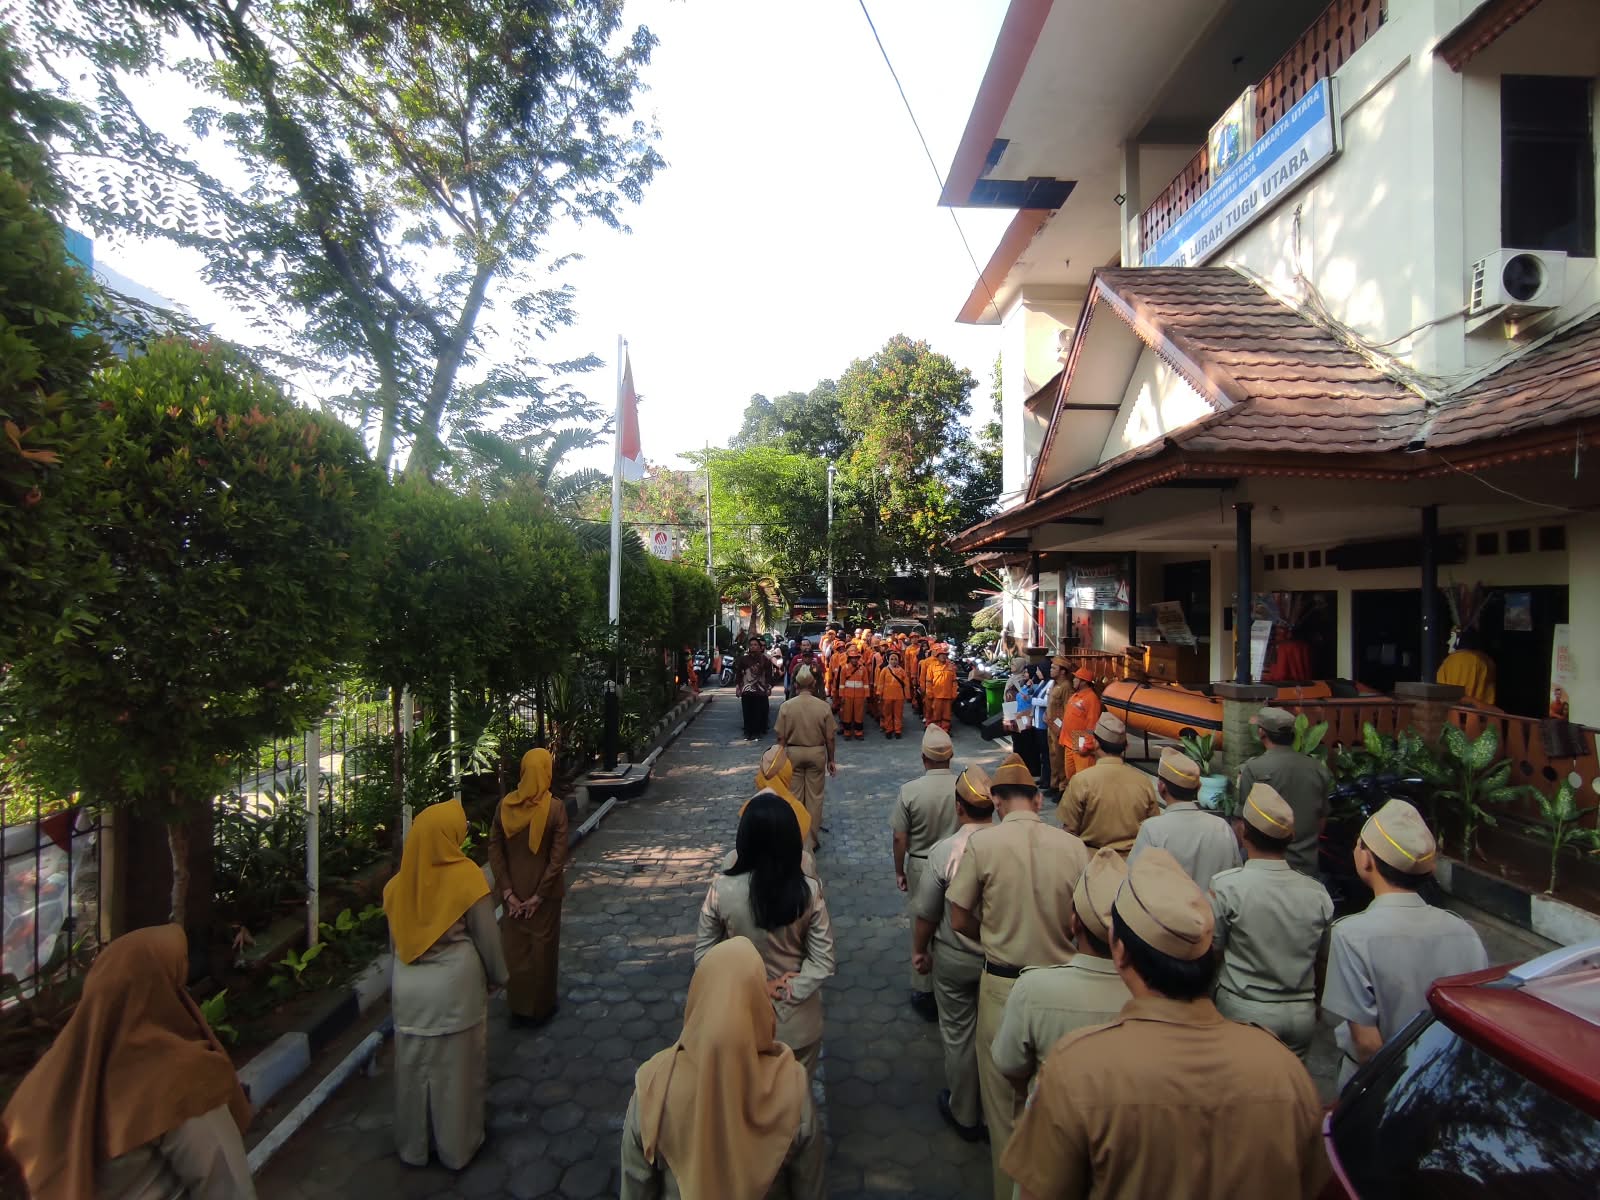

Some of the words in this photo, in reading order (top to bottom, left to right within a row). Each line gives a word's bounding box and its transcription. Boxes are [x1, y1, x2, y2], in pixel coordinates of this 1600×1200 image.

[1209, 152, 1255, 197] ADMINISTRASI
[1255, 119, 1290, 157] JAKARTA
[1291, 90, 1320, 122] UTARA
[1238, 164, 1257, 184] KOJA
[1190, 221, 1223, 259] LURAH
[1225, 189, 1258, 228] TUGU
[1262, 147, 1309, 198] UTARA
